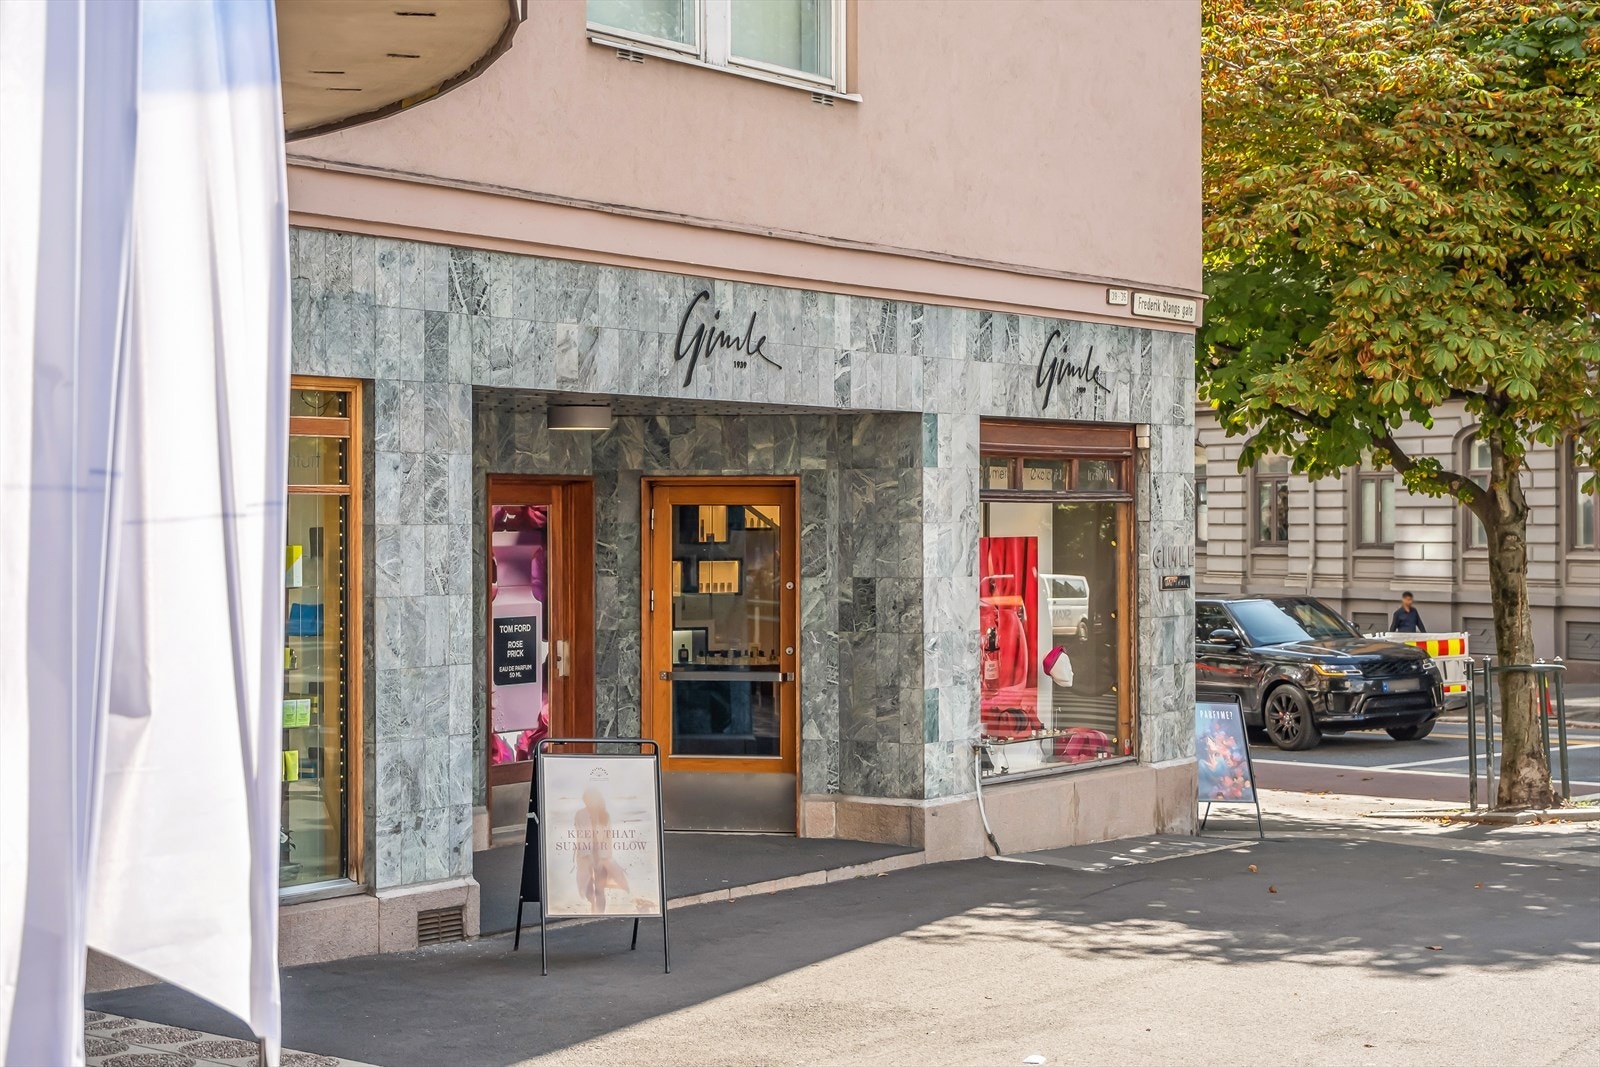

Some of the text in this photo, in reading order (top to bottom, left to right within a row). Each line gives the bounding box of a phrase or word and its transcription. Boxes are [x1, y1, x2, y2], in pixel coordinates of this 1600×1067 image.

[1138, 297, 1193, 318] Frederik Stangs gate
[674, 290, 782, 388] Gimle
[733, 361, 747, 369] 1939
[1036, 329, 1111, 410] Gimle
[1152, 545, 1194, 569] GIMLE
[499, 624, 531, 633] TOM FORD
[507, 640, 523, 648] ROSE
[507, 649, 524, 657] PRICK
[499, 665, 508, 673] EAU
[1200, 710, 1233, 720] PARFYME?
[567, 829, 636, 839] KEEP THAT
[555, 841, 647, 851] SUMMER GLOW
